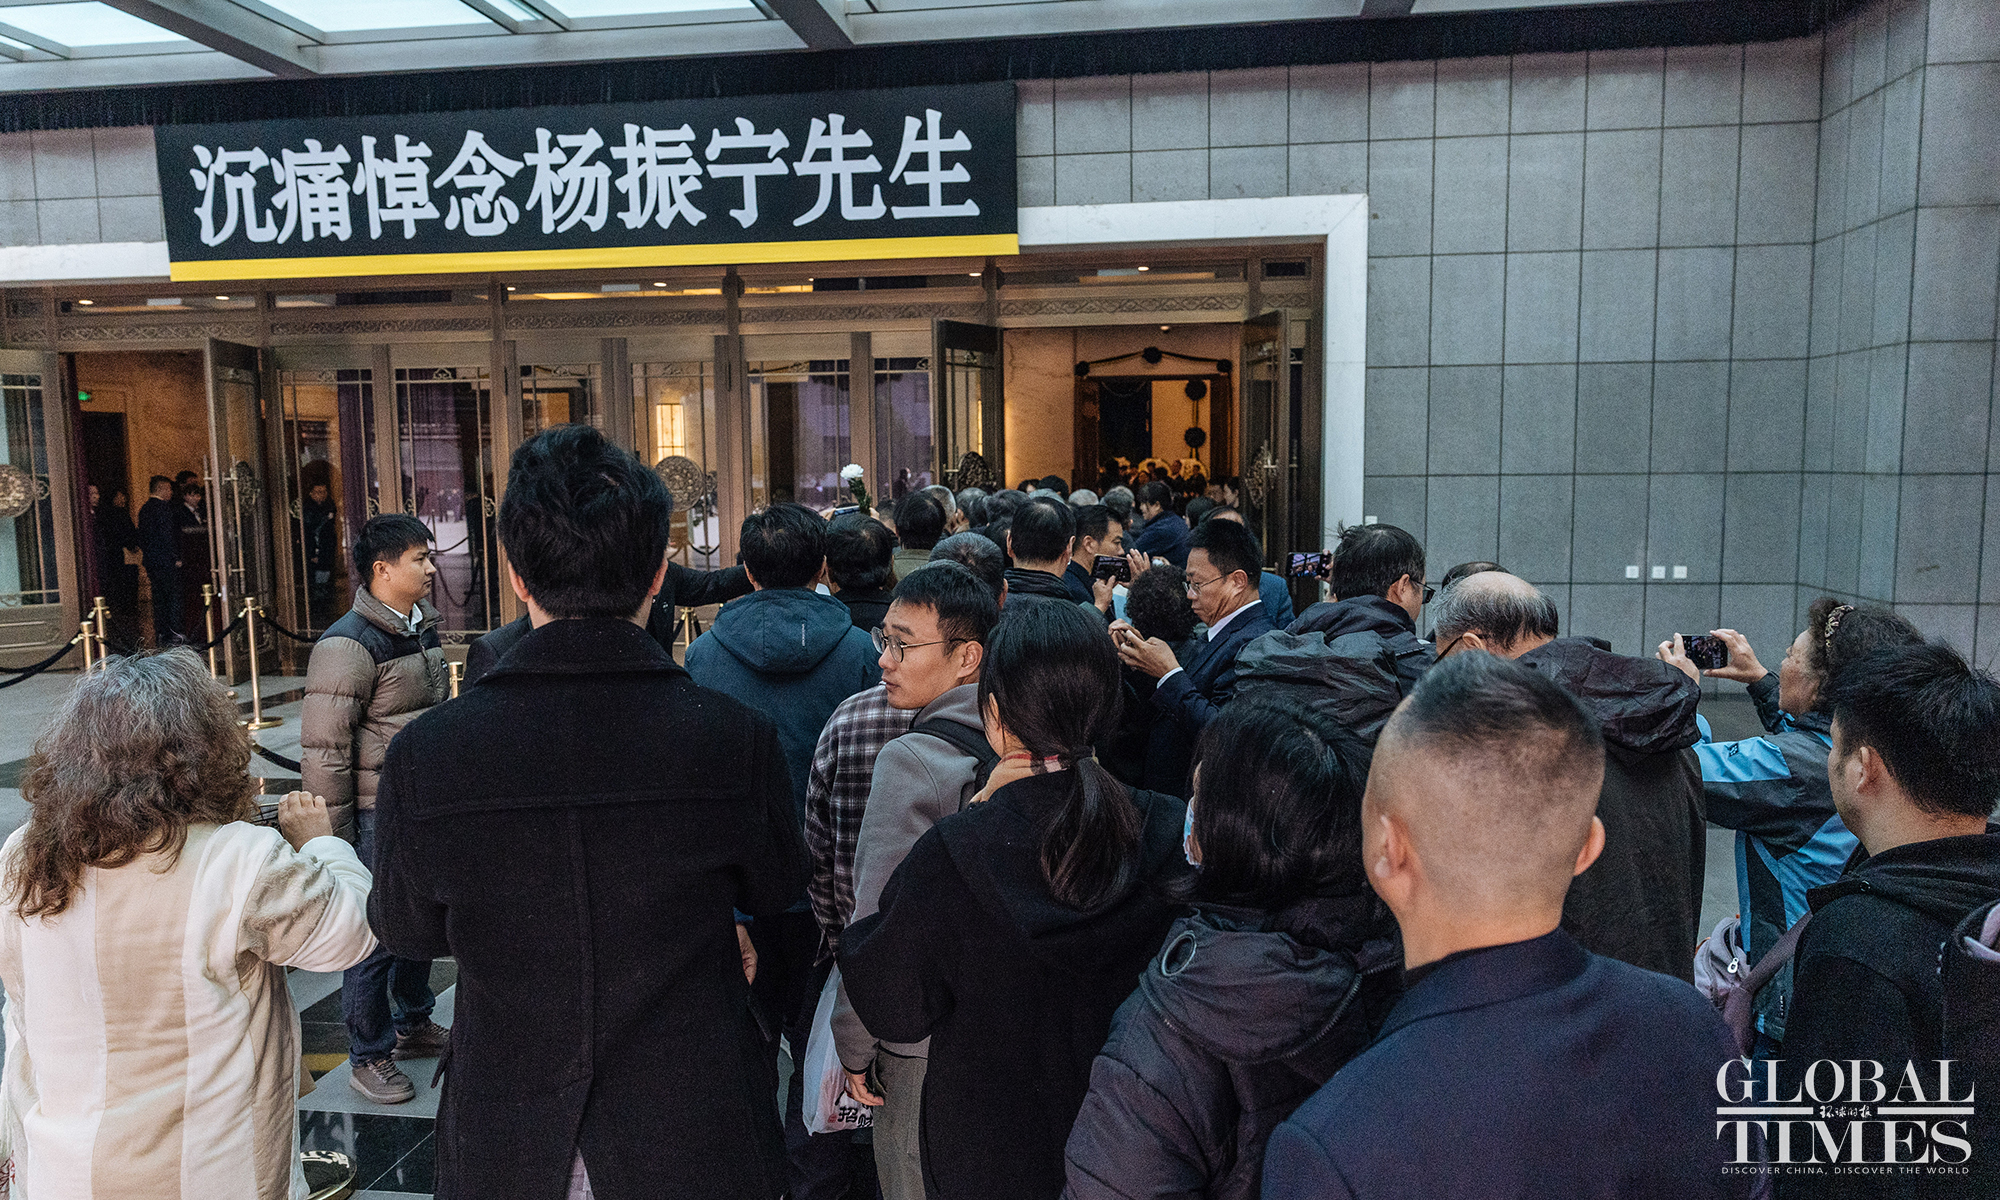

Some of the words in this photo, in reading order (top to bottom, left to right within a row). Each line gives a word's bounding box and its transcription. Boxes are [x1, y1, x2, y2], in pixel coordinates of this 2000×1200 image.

[189, 108, 980, 247] 沉痛悼念杨振宁先生
